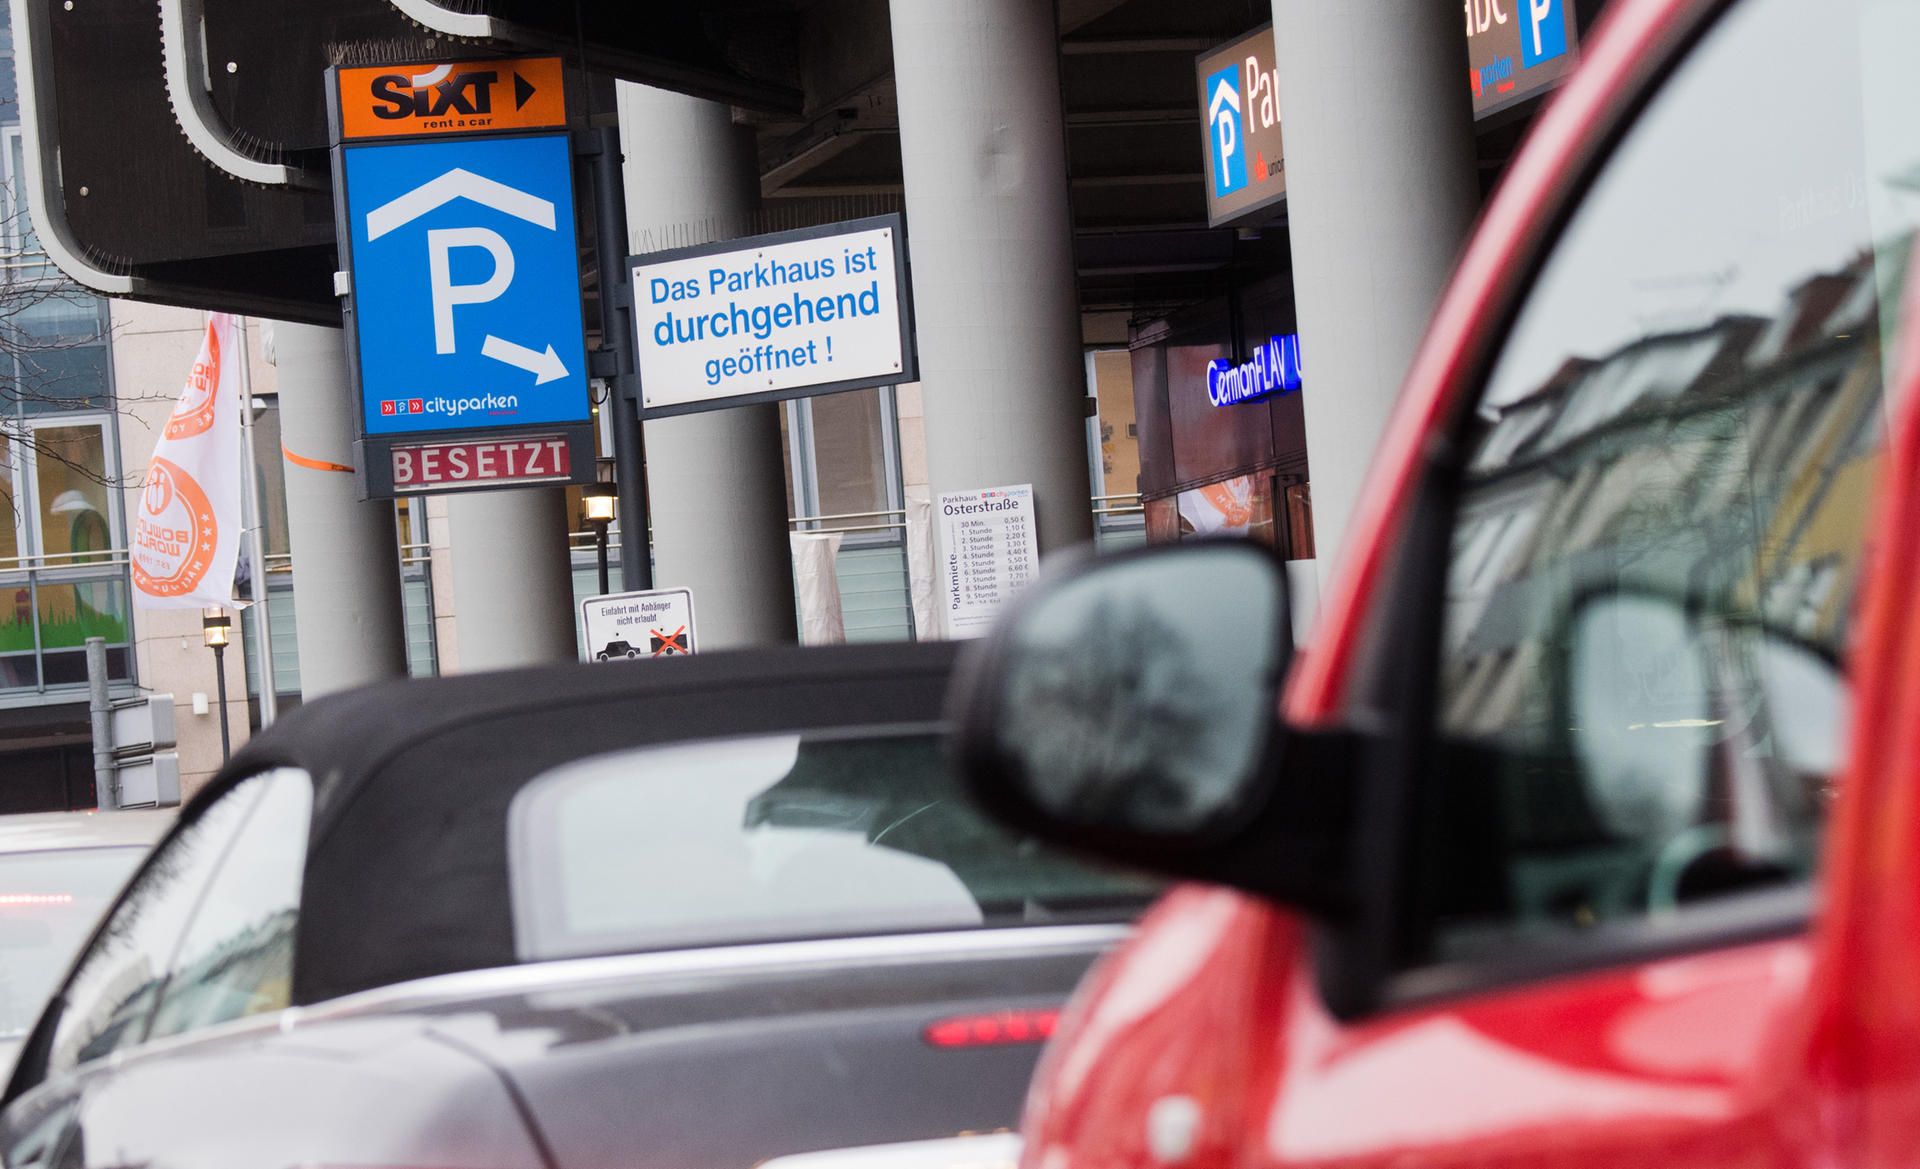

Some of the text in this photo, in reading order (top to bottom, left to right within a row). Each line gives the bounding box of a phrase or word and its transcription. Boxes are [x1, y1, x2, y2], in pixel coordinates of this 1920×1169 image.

[424, 118, 493, 129] rent a car
[427, 227, 515, 355] P
[650, 246, 877, 304] Das Parkhaus ist
[654, 280, 880, 346] durchgehend
[705, 336, 833, 386] geöffnet !
[425, 393, 518, 416] cityparken
[392, 441, 566, 482] BESETZT
[942, 496, 977, 504] Parkhaus
[944, 498, 1018, 516] Osterstraße
[950, 554, 960, 610] Parkmiete
[601, 602, 671, 616] Einfahrt mit Anhänger
[616, 614, 656, 626] nicht erlaubt
